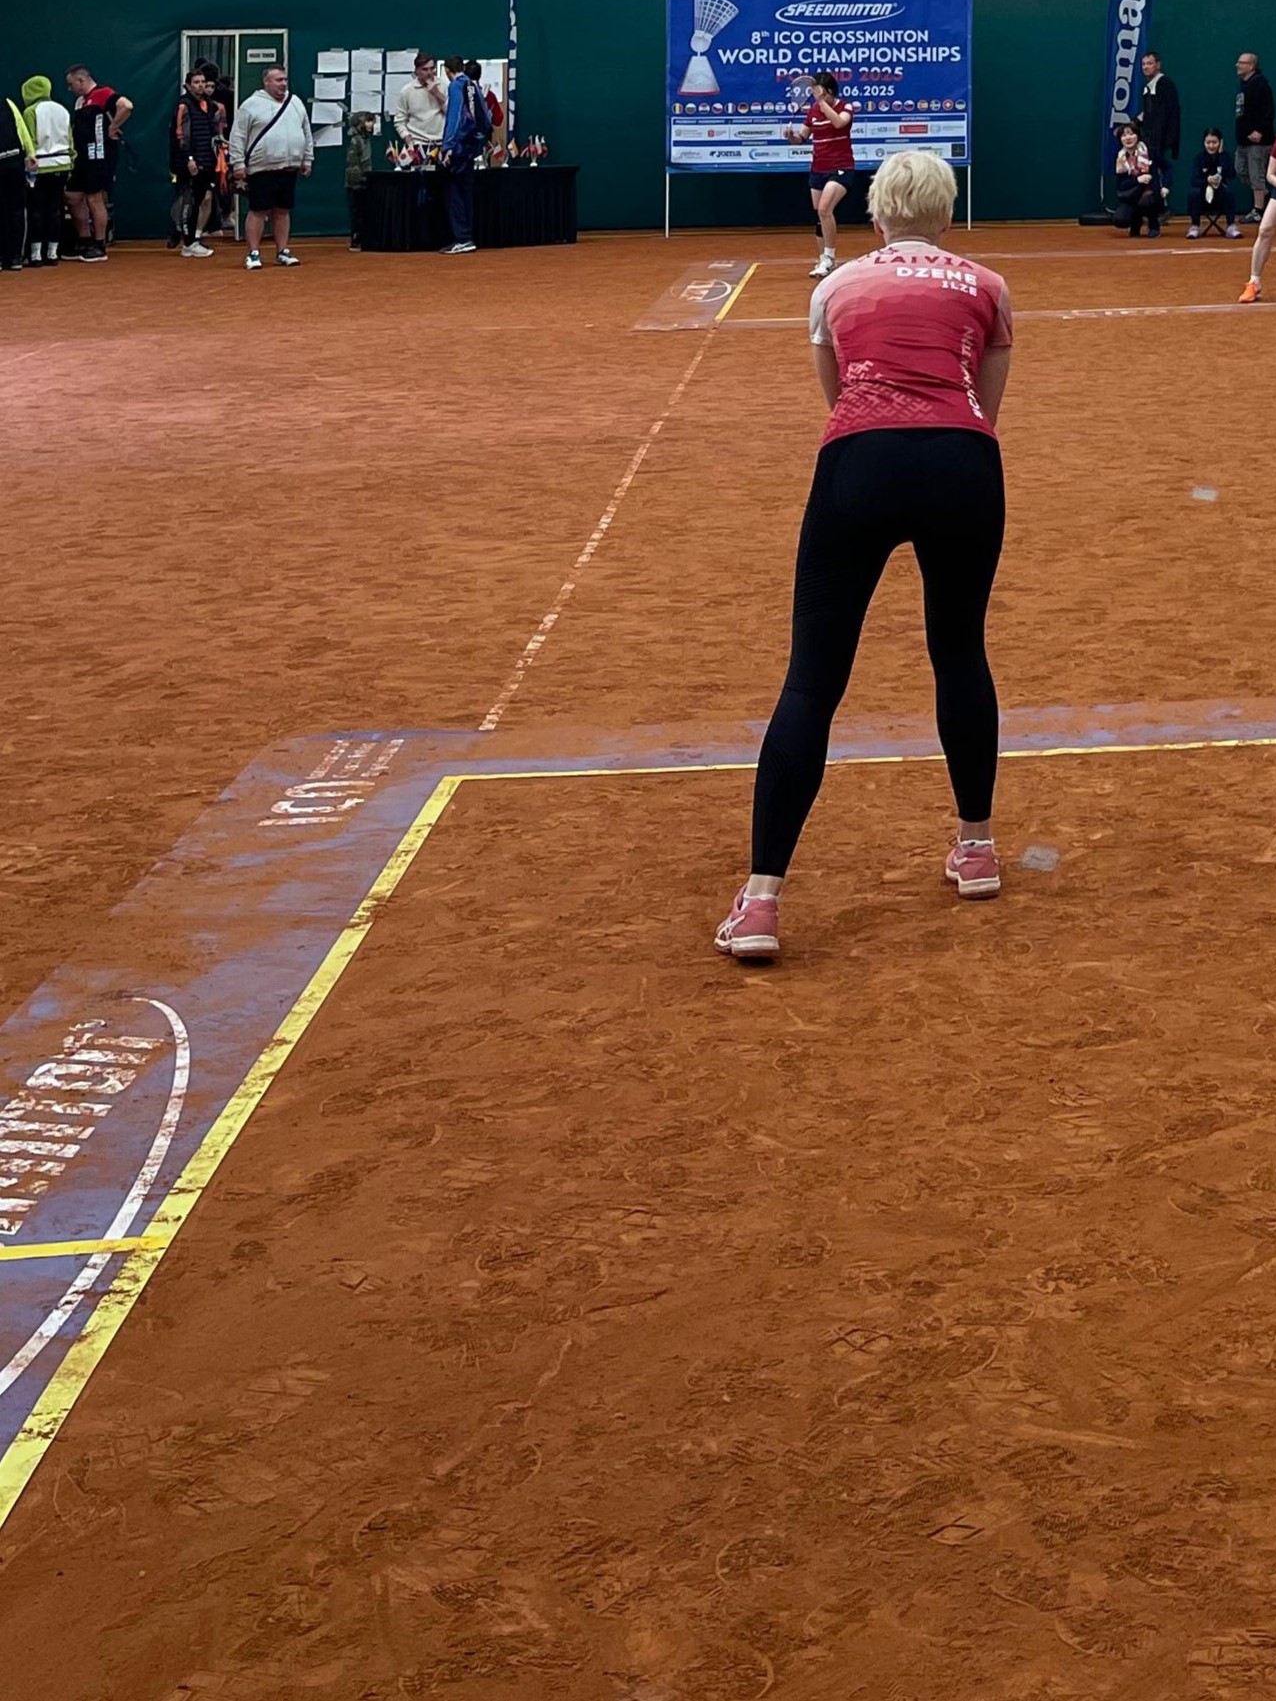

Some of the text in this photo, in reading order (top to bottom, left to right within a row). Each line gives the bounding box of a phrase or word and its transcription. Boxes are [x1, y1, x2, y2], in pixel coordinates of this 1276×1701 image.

[751, 29, 929, 44] 8th ICO CROSSMINTON
[717, 46, 962, 65] WORLD CHAMPIONSHIPS
[858, 66, 904, 81] 2025
[873, 255, 974, 270] LATVIA
[896, 266, 977, 286] DZENE
[940, 280, 978, 297] ILZE
